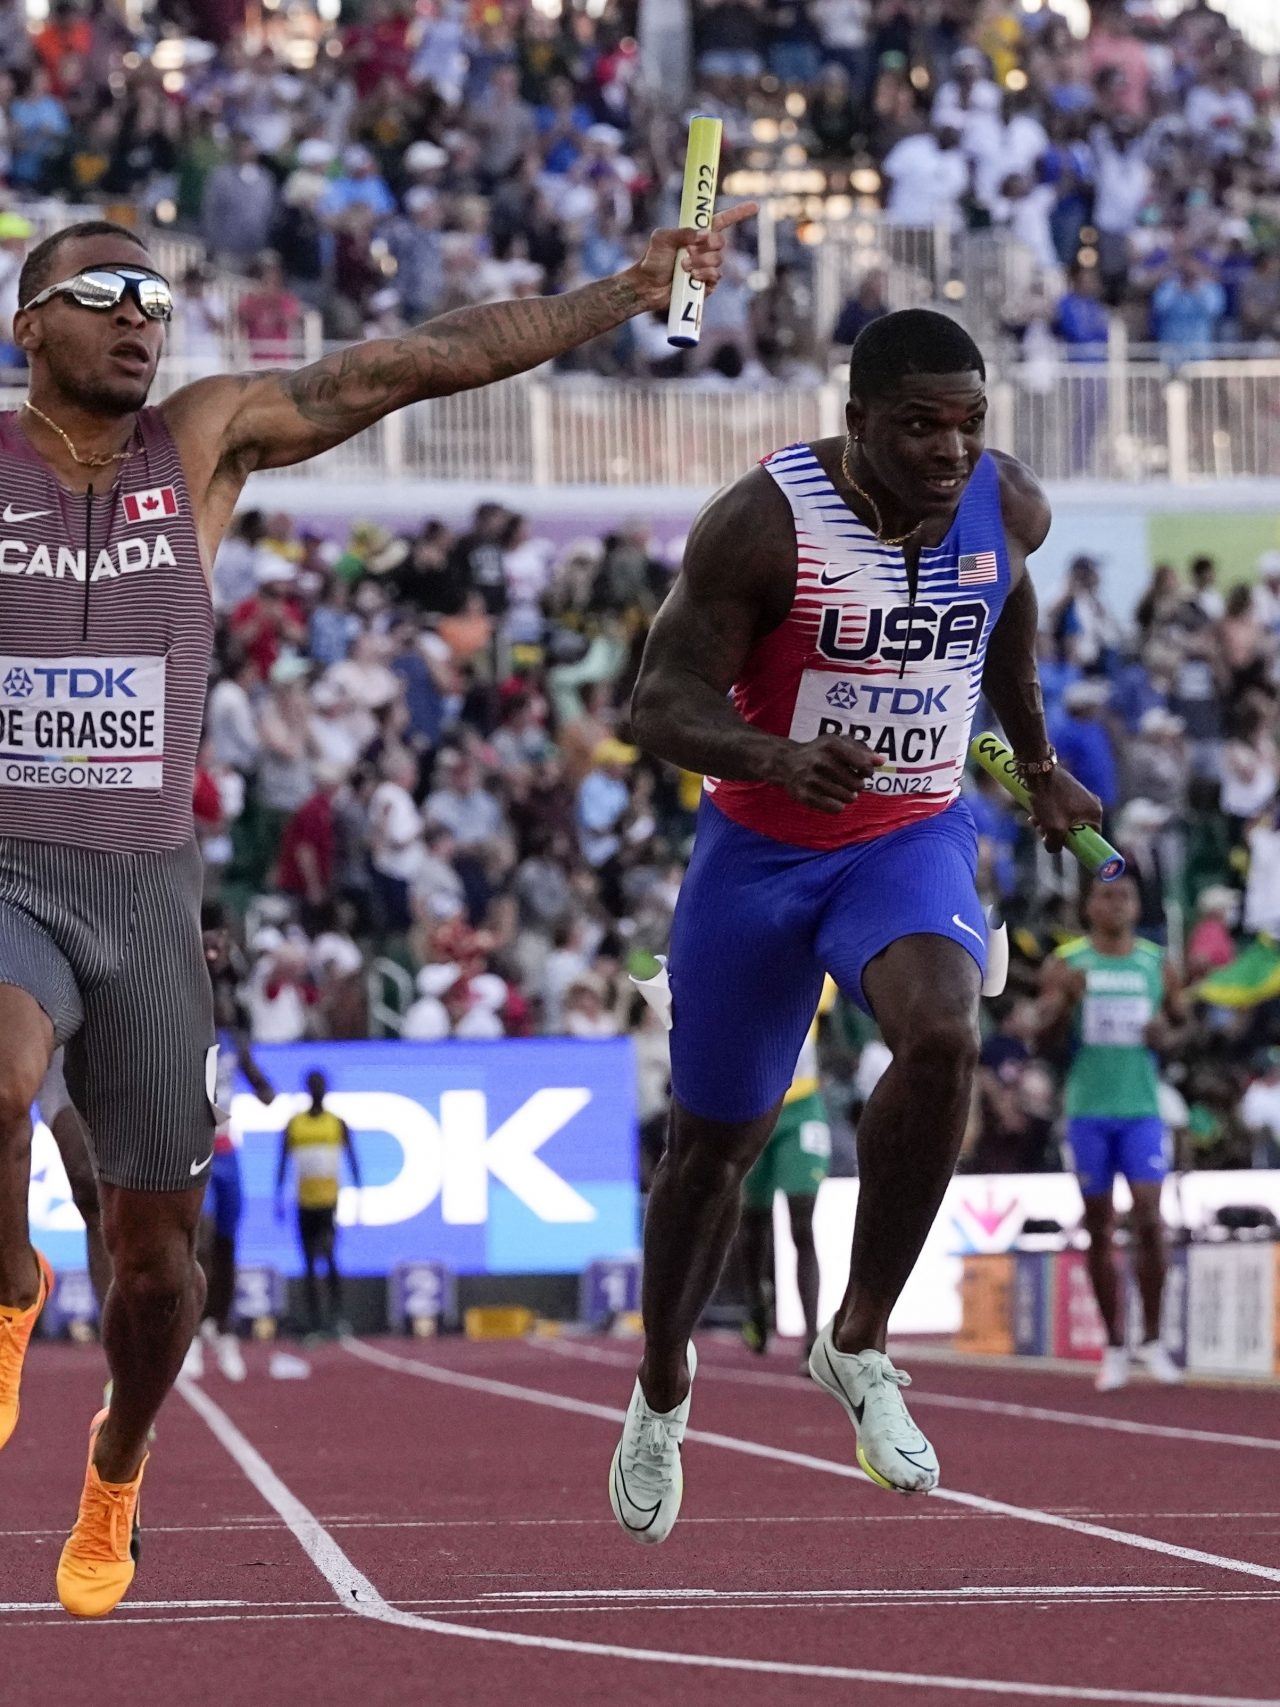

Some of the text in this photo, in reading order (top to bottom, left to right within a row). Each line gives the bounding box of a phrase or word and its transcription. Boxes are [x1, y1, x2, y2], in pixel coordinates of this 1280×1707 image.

[818, 600, 989, 662] USA
[34, 667, 137, 698] TDK
[859, 684, 952, 716] TDK
[35, 709, 155, 749] GRASSE
[6, 764, 133, 786] OREGON22
